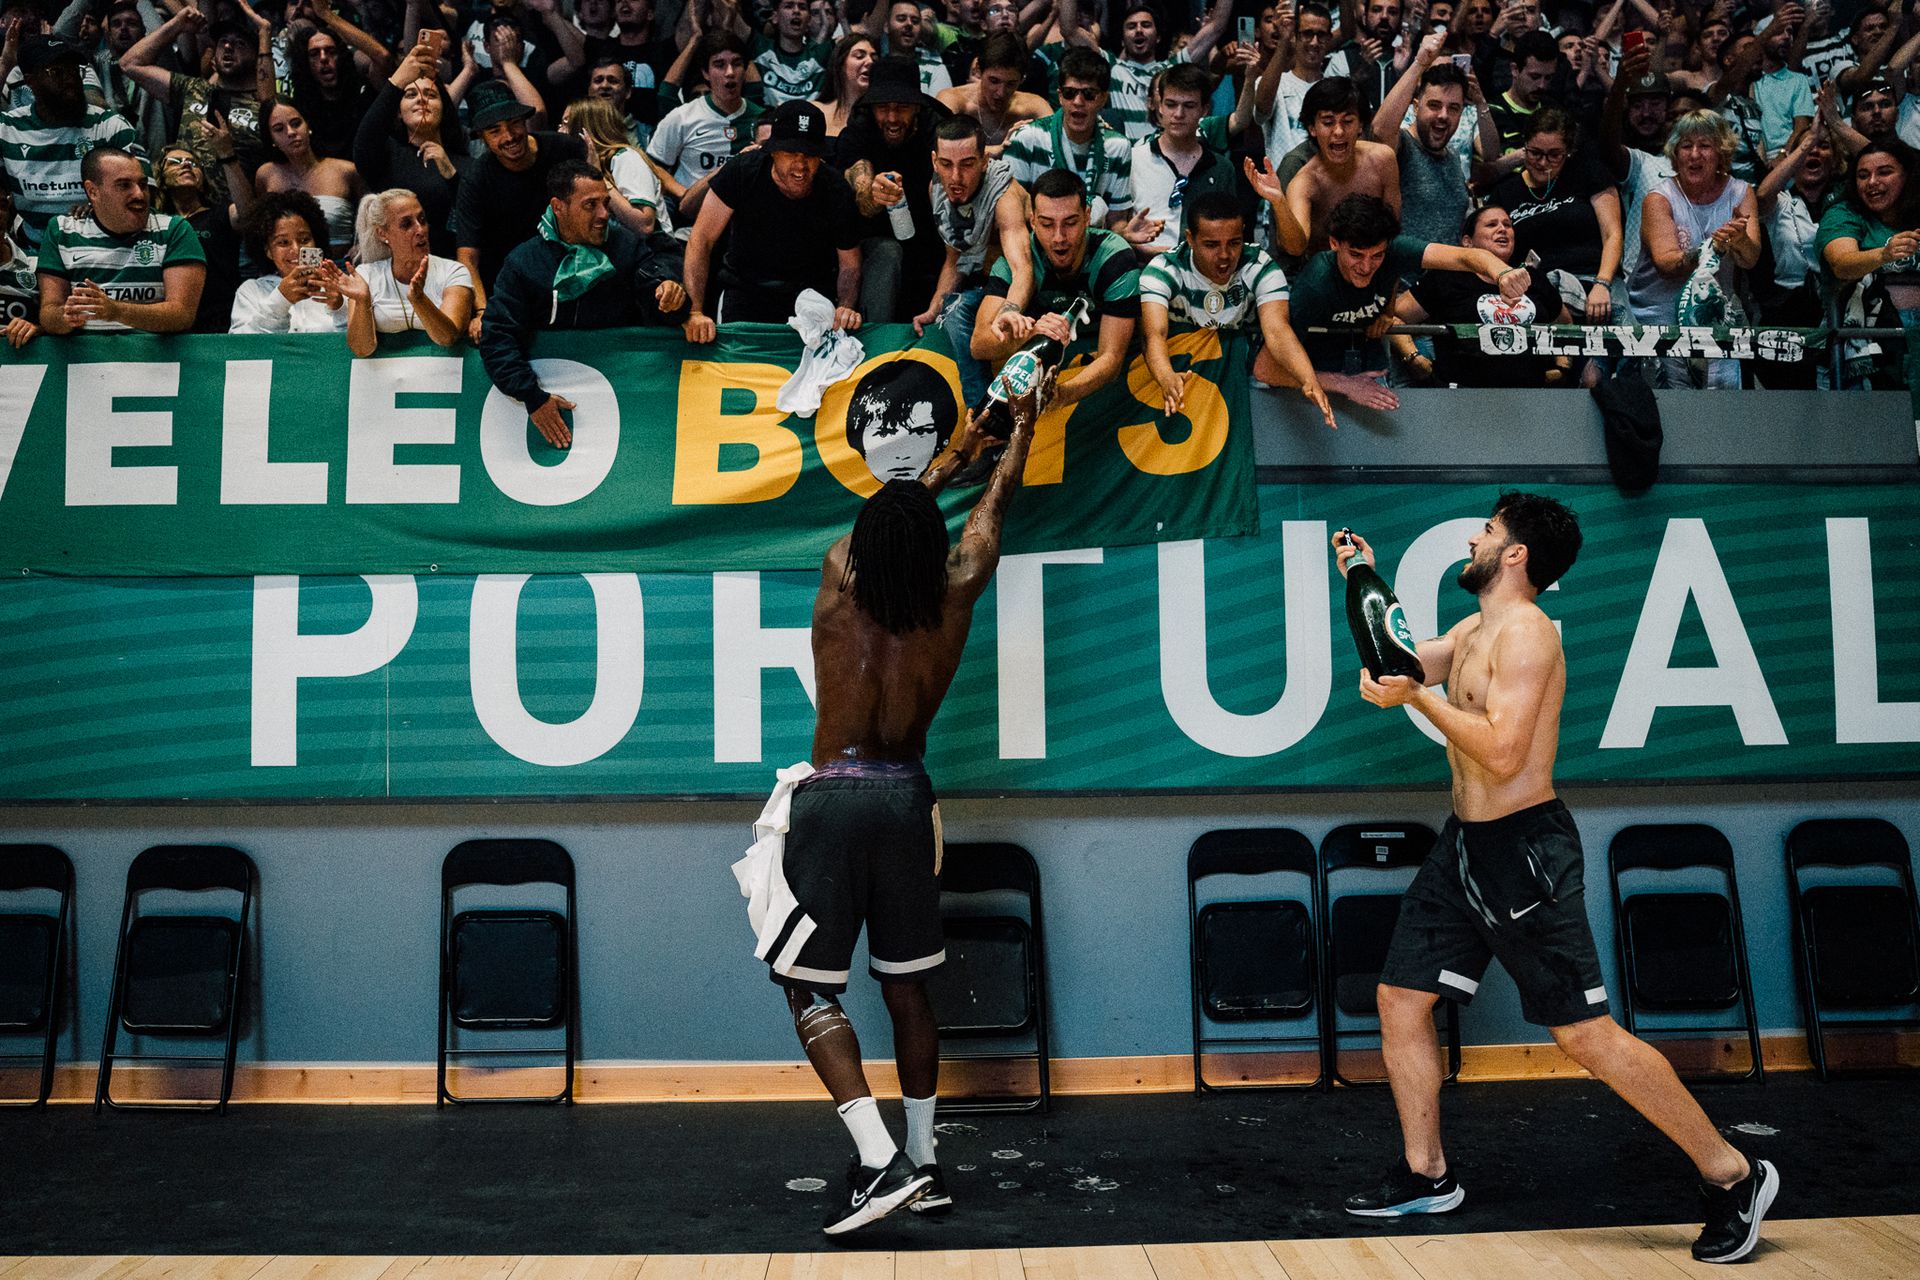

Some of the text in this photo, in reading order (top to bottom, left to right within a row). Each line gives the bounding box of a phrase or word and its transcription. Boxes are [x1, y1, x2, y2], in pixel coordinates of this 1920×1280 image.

[22, 179, 84, 191] inetum
[102, 286, 156, 302] ETANO
[1478, 323, 1806, 363] OLIVAIS
